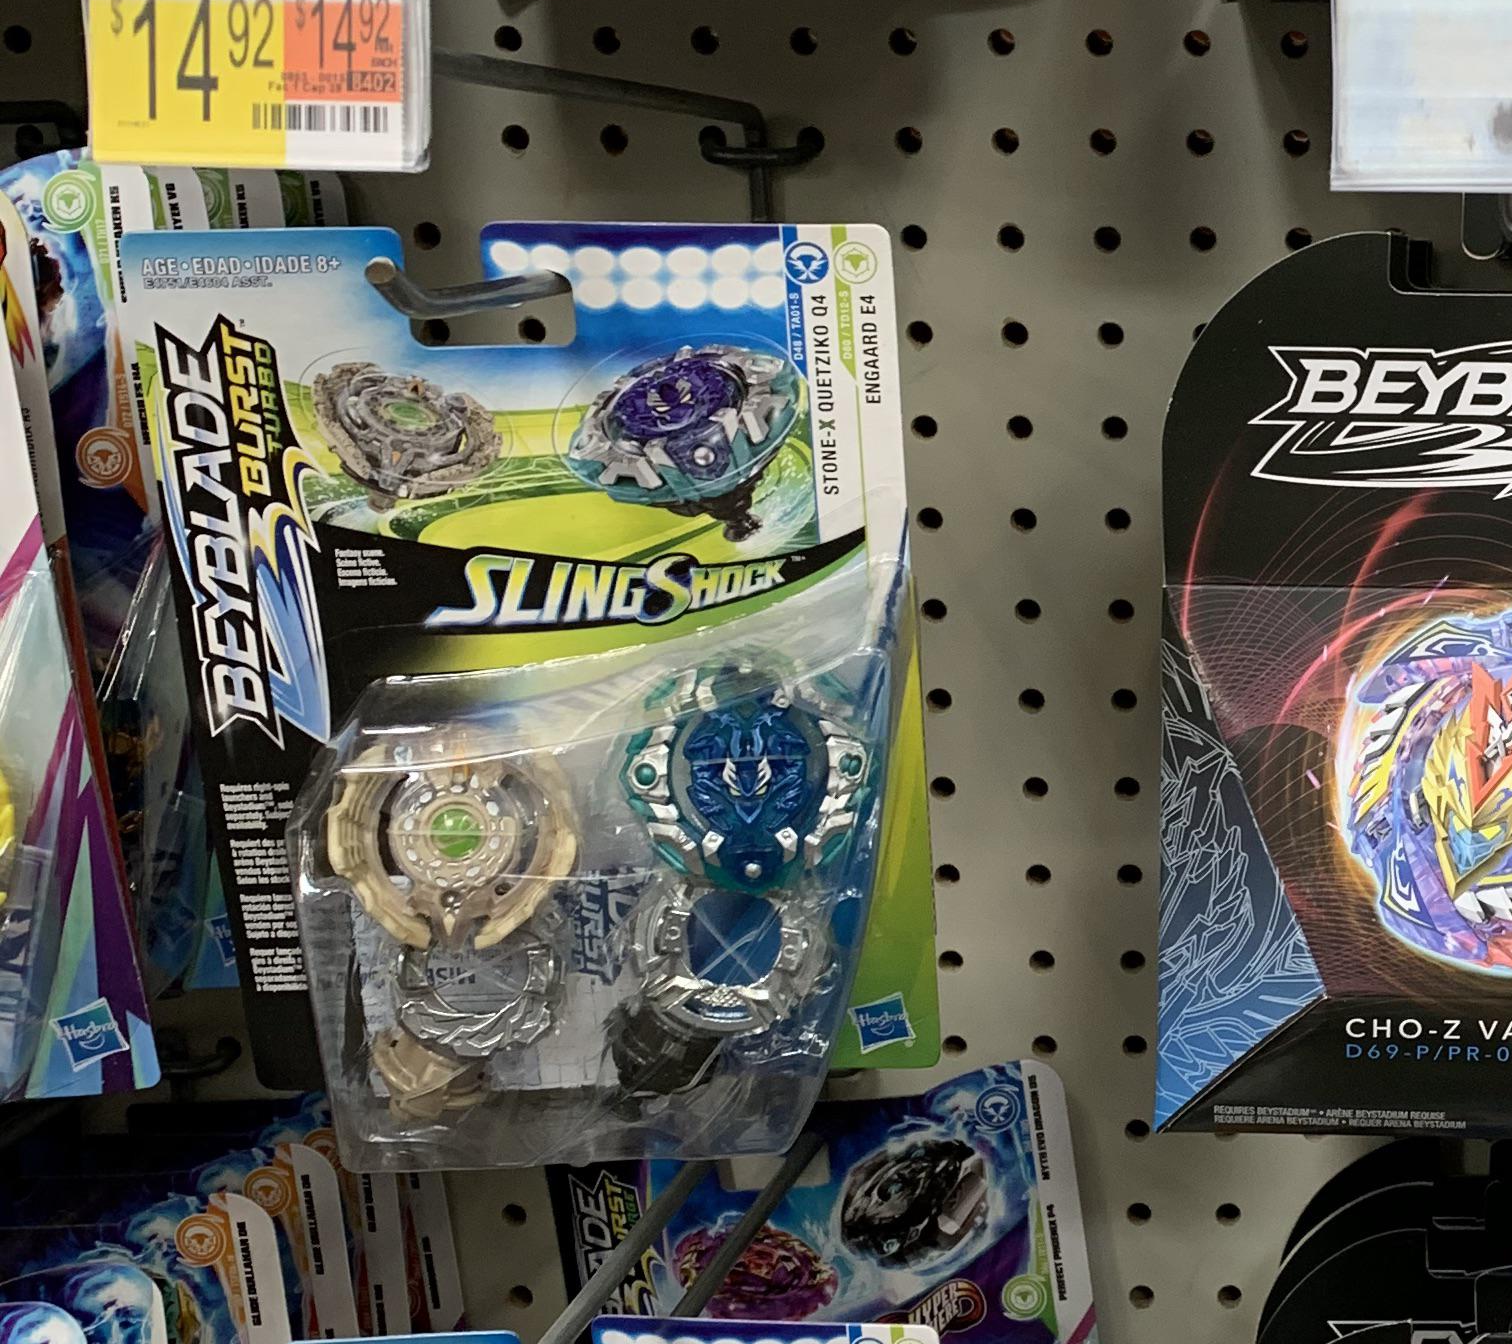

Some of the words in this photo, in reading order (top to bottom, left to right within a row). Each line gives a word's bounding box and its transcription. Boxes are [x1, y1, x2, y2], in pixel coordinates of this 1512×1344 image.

[316, 255, 341, 273] 8+
[816, 294, 828, 320] Q4
[863, 294, 876, 320] E4
[257, 340, 282, 455] TURBO
[816, 323, 836, 412] QUETZIKO
[864, 325, 881, 405] ENGAARD
[219, 323, 271, 498] BURST
[819, 414, 839, 496] STONE-X
[165, 337, 268, 723] BEYBLADE
[1345, 1018, 1461, 1040] CHO-Z
